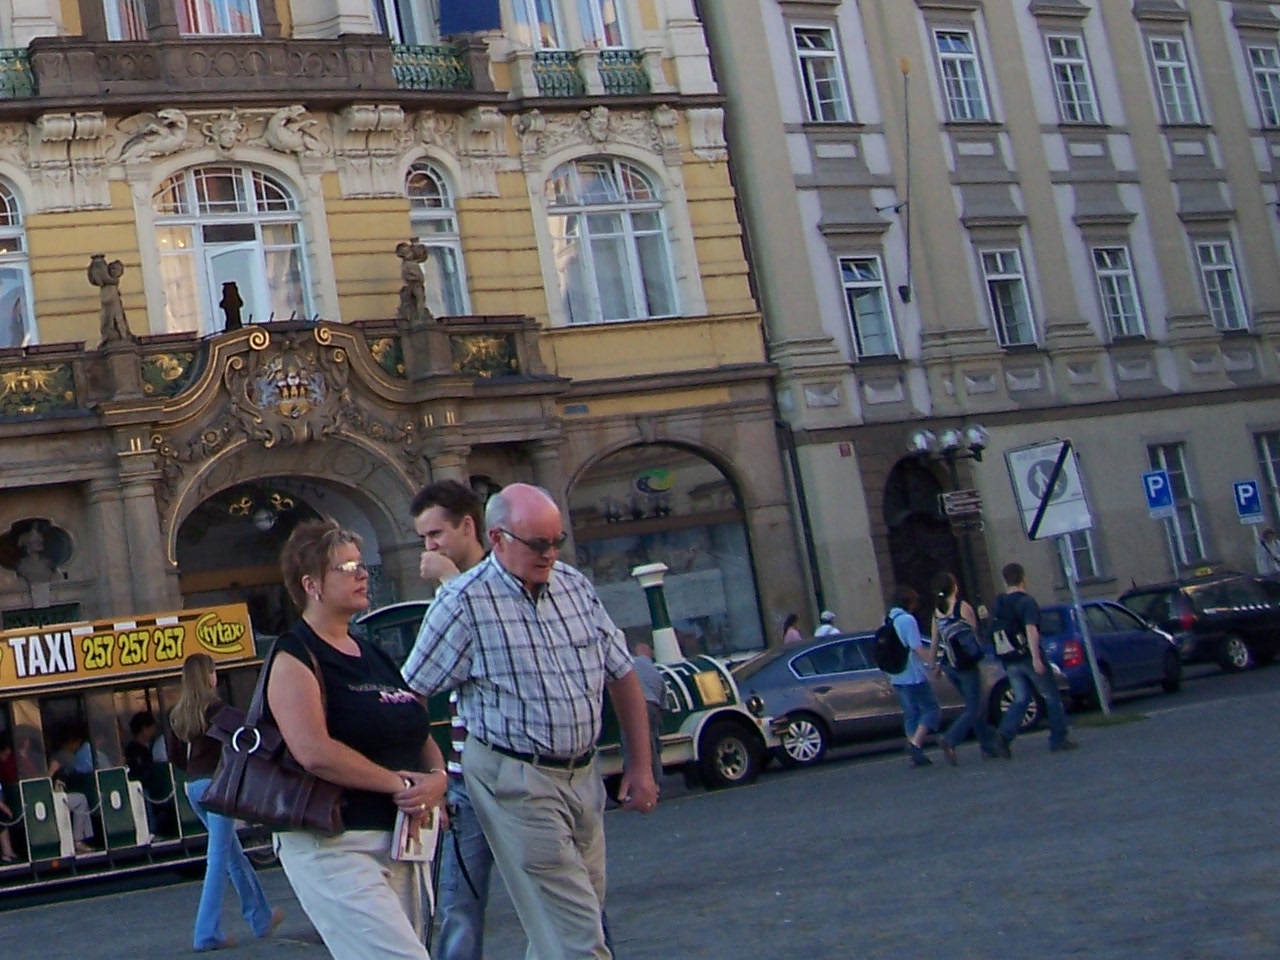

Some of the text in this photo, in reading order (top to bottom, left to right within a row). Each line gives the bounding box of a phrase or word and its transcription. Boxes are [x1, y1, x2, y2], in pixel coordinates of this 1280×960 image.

[1147, 475, 1164, 498] P
[1237, 484, 1254, 505] P
[9, 630, 77, 677] TAXI
[82, 634, 114, 670] 257
[118, 630, 149, 666] 257
[153, 626, 185, 661] 257
